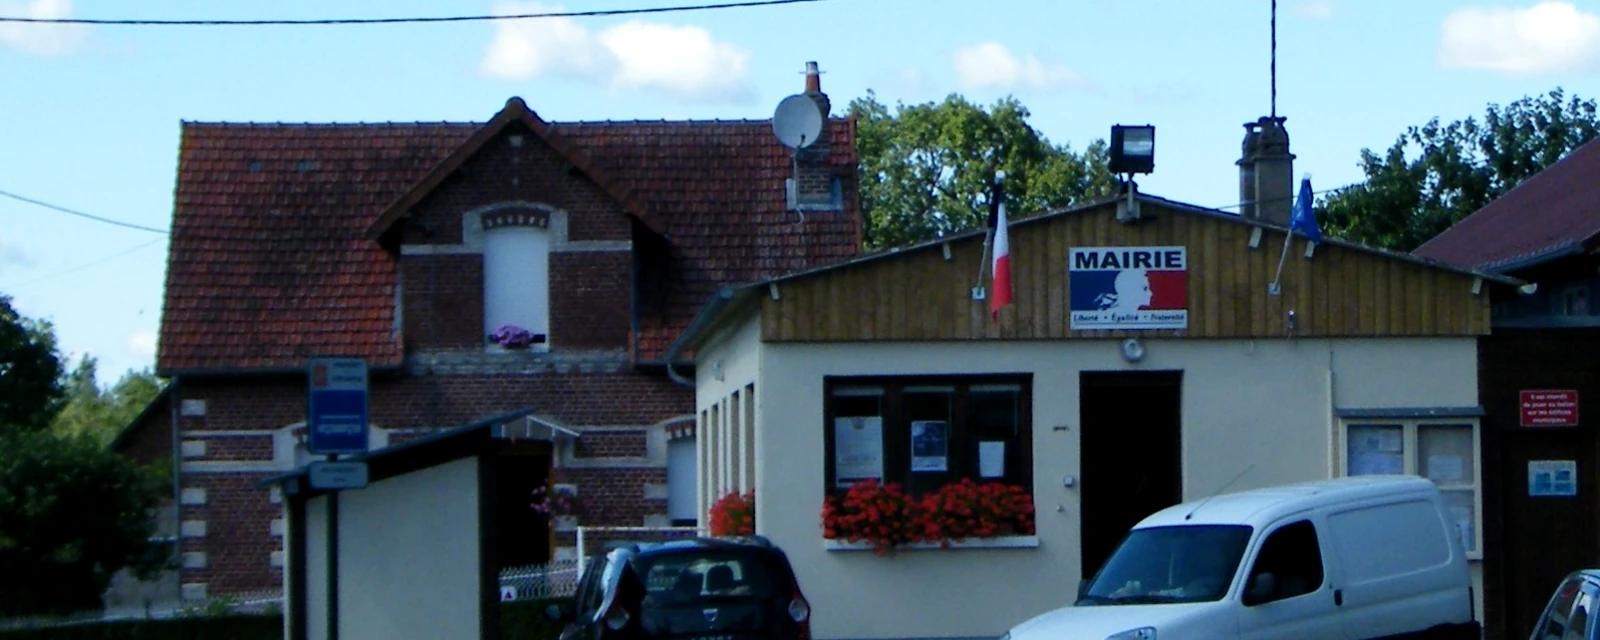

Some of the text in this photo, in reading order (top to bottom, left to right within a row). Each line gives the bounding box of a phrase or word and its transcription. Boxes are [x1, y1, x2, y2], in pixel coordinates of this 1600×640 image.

[1075, 251, 1182, 269] MAIRIE
[1073, 314, 1099, 322] Liberté
[1150, 313, 1185, 321] Fraternité
